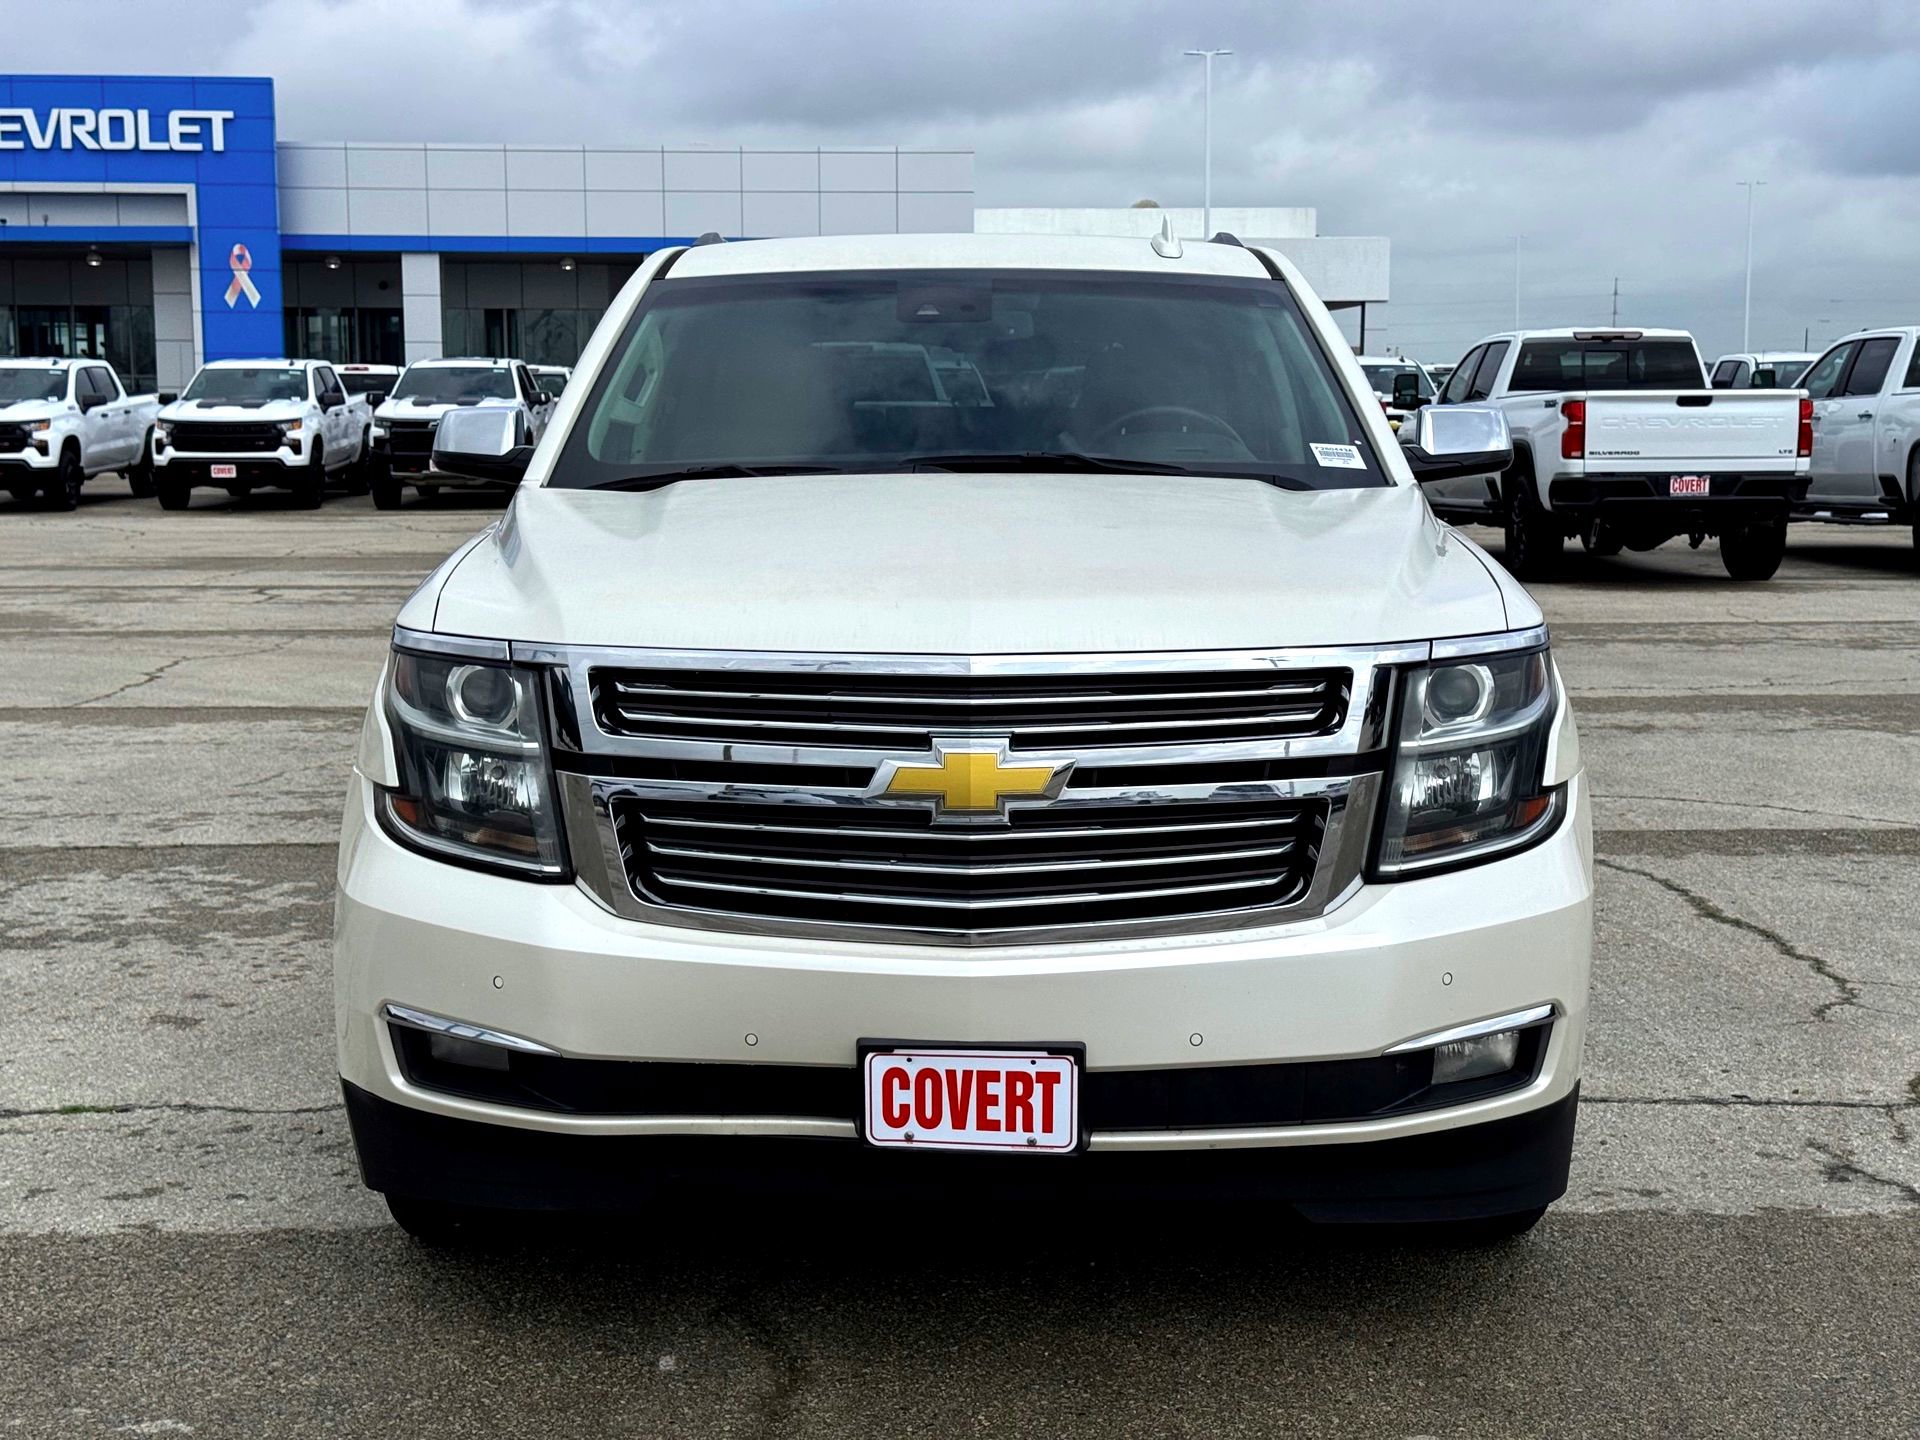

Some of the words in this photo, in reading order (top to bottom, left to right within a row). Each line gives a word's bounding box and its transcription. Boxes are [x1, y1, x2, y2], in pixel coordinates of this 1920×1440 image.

[1599, 416, 1785, 429] CHEVROLET
[1672, 477, 1707, 493] COVERT
[881, 1066, 1062, 1134] COVERT
